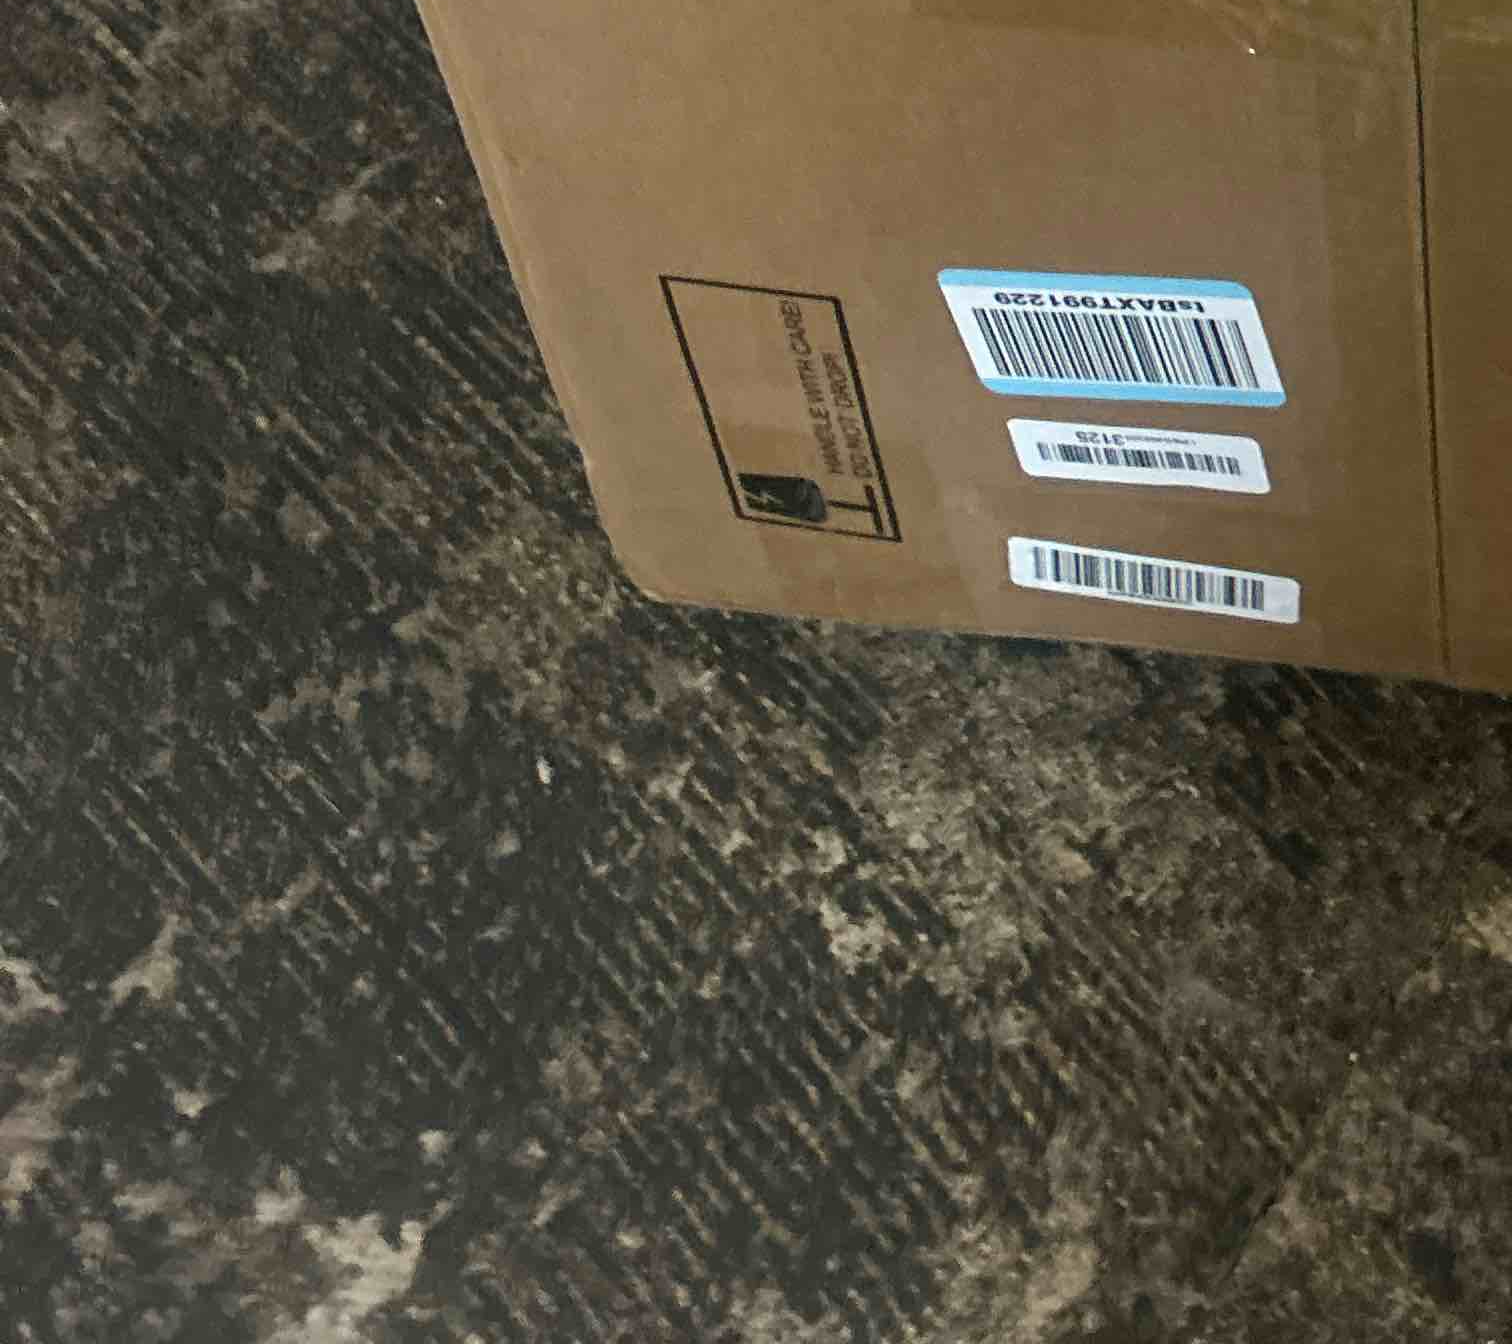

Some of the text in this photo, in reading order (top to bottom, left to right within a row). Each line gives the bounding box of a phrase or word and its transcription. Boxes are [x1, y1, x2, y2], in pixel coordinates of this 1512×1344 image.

[797, 359, 825, 403] WITH
[809, 407, 845, 475] HANDLE
[837, 414, 863, 450] NOT
[849, 451, 874, 479] DO
